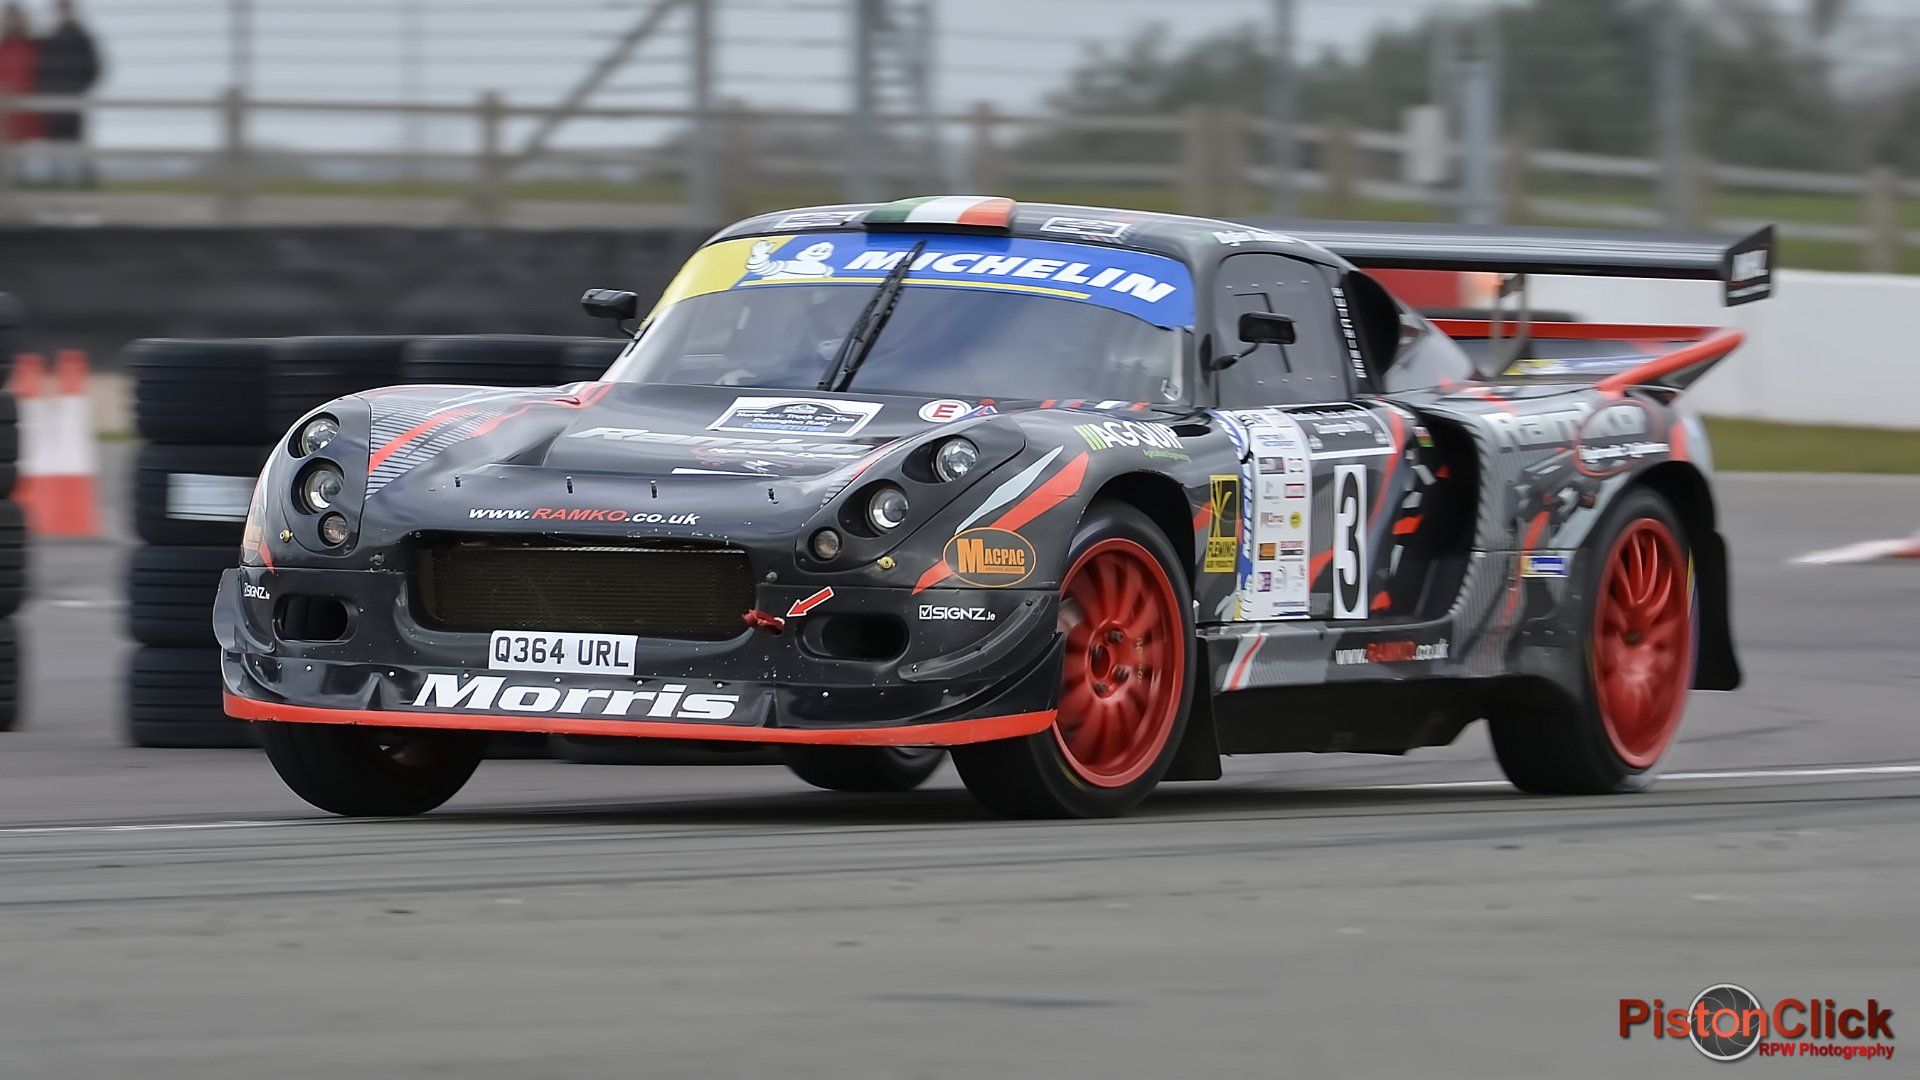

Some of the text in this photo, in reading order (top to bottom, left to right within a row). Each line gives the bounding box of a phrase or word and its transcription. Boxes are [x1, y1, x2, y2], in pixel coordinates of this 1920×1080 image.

[843, 250, 1177, 303] MICHELIN
[932, 403, 959, 418] E
[567, 427, 877, 454] Ramko
[742, 422, 828, 432] COMPETITOR
[469, 507, 700, 526] www.RAMKO.co.uk
[957, 538, 1025, 573] MACPAC
[1207, 541, 1236, 558] FLEMING
[1338, 471, 1361, 613] 3
[495, 636, 630, 668] Q364 URL
[411, 673, 740, 720] Morris
